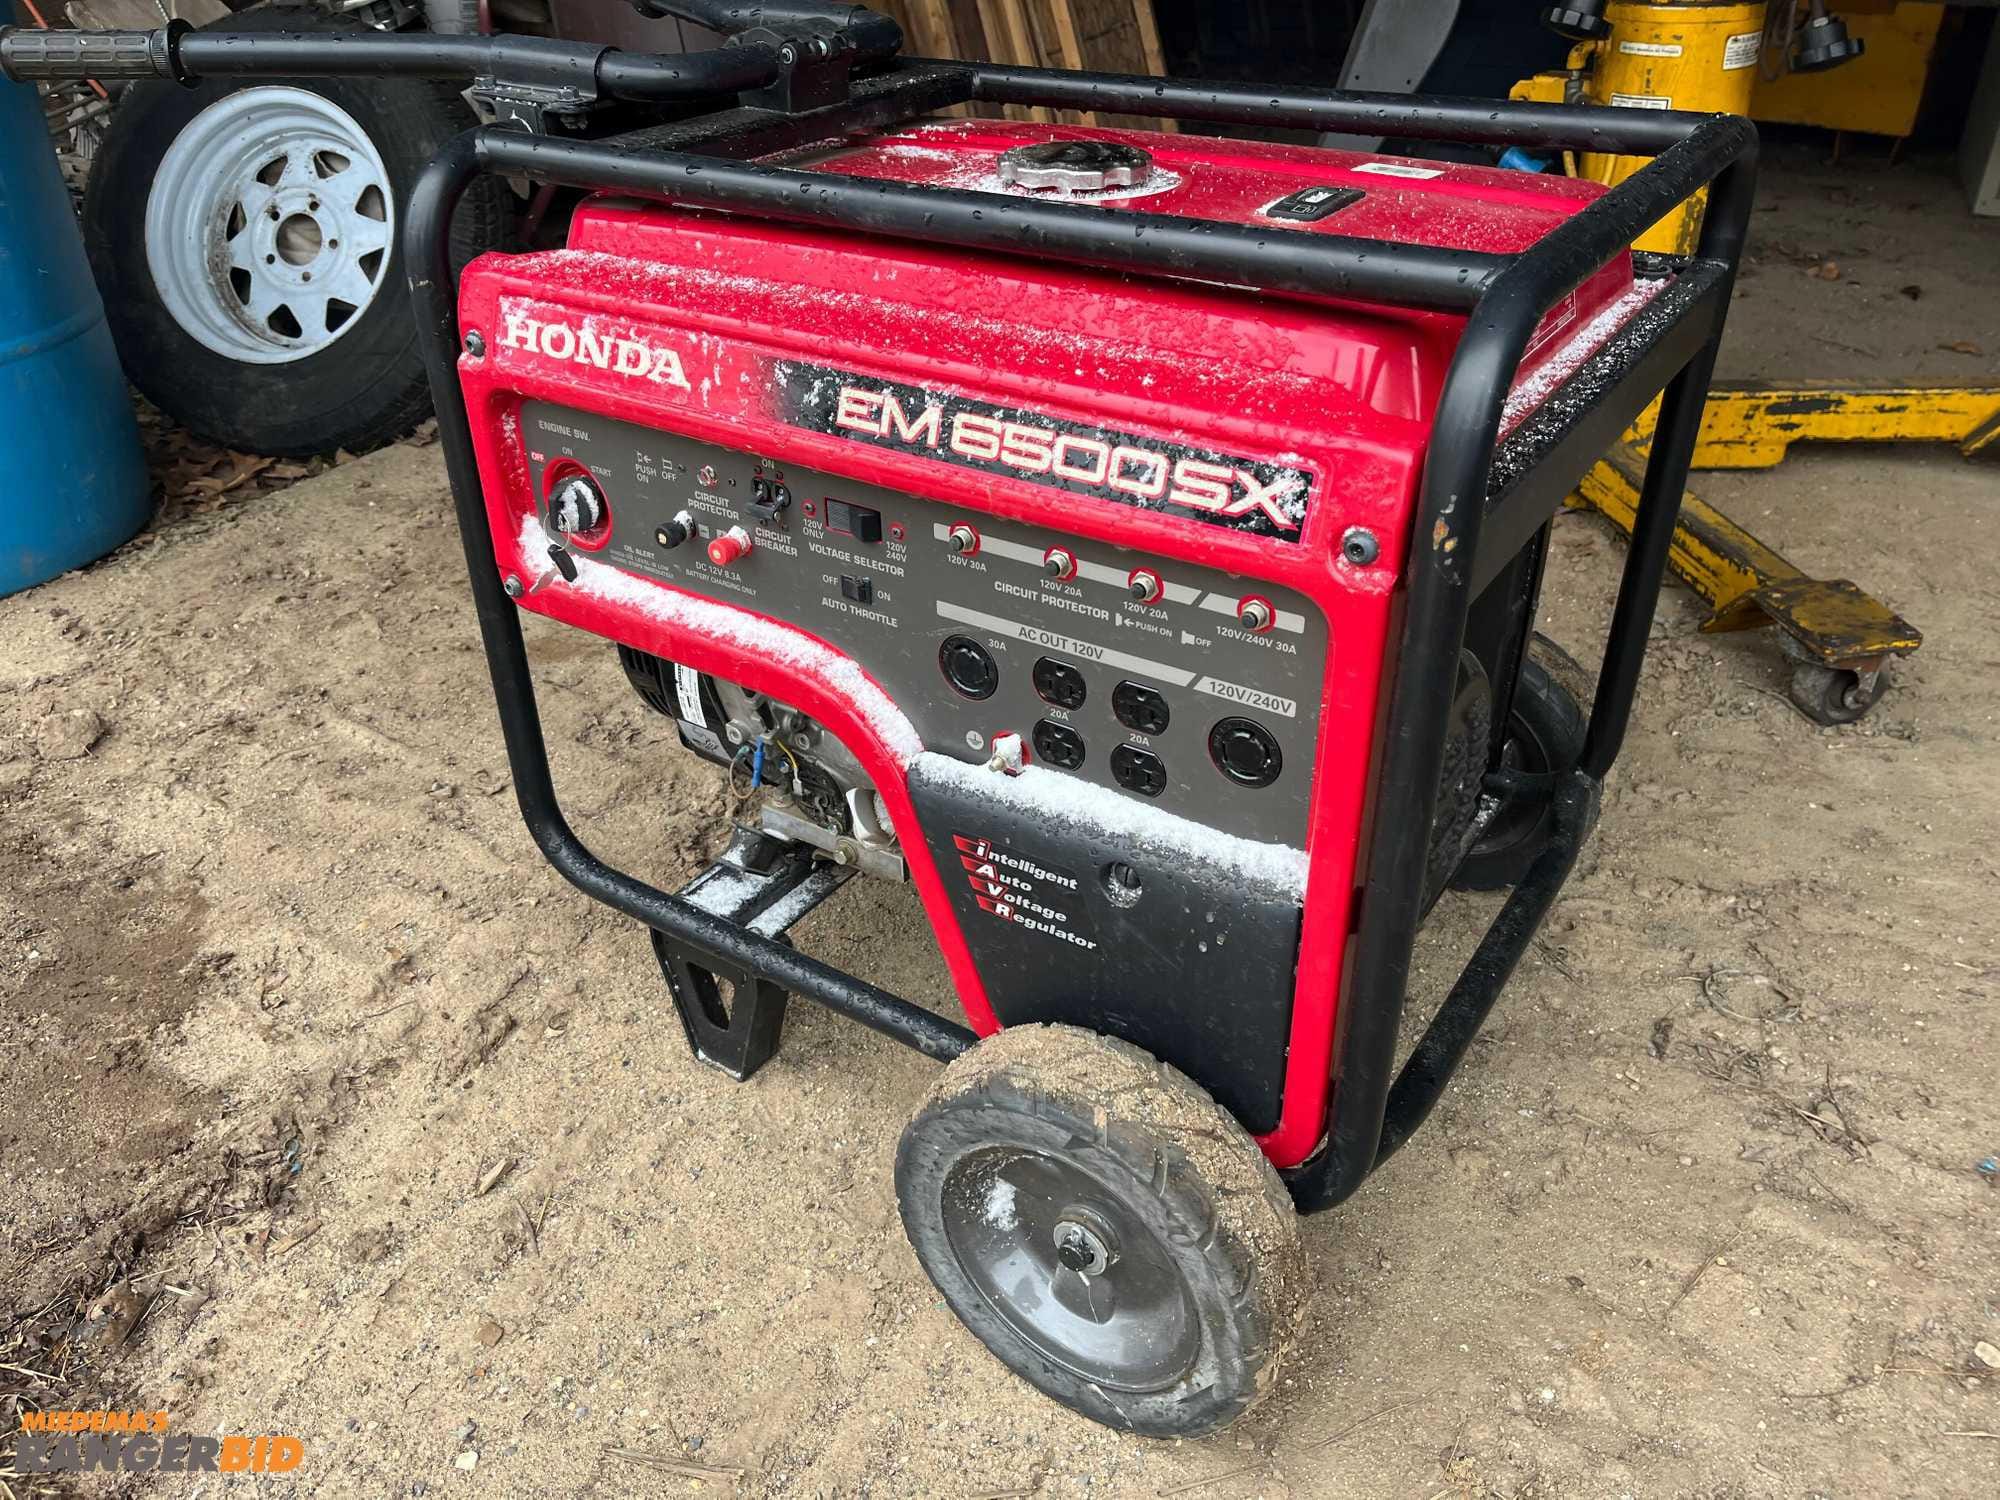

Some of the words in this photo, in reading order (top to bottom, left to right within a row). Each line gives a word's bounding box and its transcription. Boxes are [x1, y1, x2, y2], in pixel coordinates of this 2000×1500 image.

[499, 314, 691, 391] HONDA
[538, 420, 572, 437] ENGINE
[562, 447, 573, 456] ON
[590, 465, 612, 477] START
[635, 463, 657, 477] PUSH
[761, 459, 775, 469] ON
[637, 473, 649, 484] ON
[661, 472, 677, 482] OFF
[694, 490, 729, 507] CIRCUIT
[687, 498, 740, 521] PROTECTOR
[803, 519, 823, 530] 120V
[755, 527, 792, 544] CIRCUIT
[802, 527, 824, 540] ONLY
[754, 537, 798, 557] BREAKER
[886, 541, 907, 553] 120V
[808, 542, 851, 562] VOLTAGE
[853, 555, 905, 577] SELECTOR
[886, 550, 907, 562] 240V
[946, 553, 969, 566] 120V
[970, 560, 987, 572] 30A
[695, 561, 708, 572] DC
[709, 566, 723, 577] 12V
[724, 570, 742, 582] 8.3A
[822, 574, 839, 585] OFF
[685, 569, 710, 581] BATTERY
[711, 576, 742, 592] CHARGING
[742, 585, 757, 596] ONLY
[1039, 579, 1062, 592] 120V
[1064, 585, 1083, 598] 20A
[877, 590, 891, 601] ON
[994, 581, 1038, 601] CIRCUIT
[1041, 594, 1110, 621] PROTECTOR
[821, 597, 848, 612] AUTO
[849, 605, 898, 628] THROTTLE
[1122, 601, 1148, 615] 120V
[1149, 607, 1169, 621] 20A
[1135, 620, 1158, 633] PUSH
[1159, 628, 1173, 638] ON
[987, 638, 1007, 651] 30A
[1018, 626, 1037, 641] AC
[1039, 632, 1069, 650] OUT
[1071, 642, 1104, 660] 120V
[1195, 637, 1212, 647] OFF
[1216, 626, 1273, 648] 120V/240V
[1275, 640, 1297, 655] 30A
[1209, 681, 1293, 714] 120V/240V
[1050, 708, 1069, 721] 20A
[1129, 733, 1150, 746] 20A
[975, 864, 1033, 893] Auto
[987, 881, 1067, 923] Voltage
[994, 902, 1097, 951] Regulator
